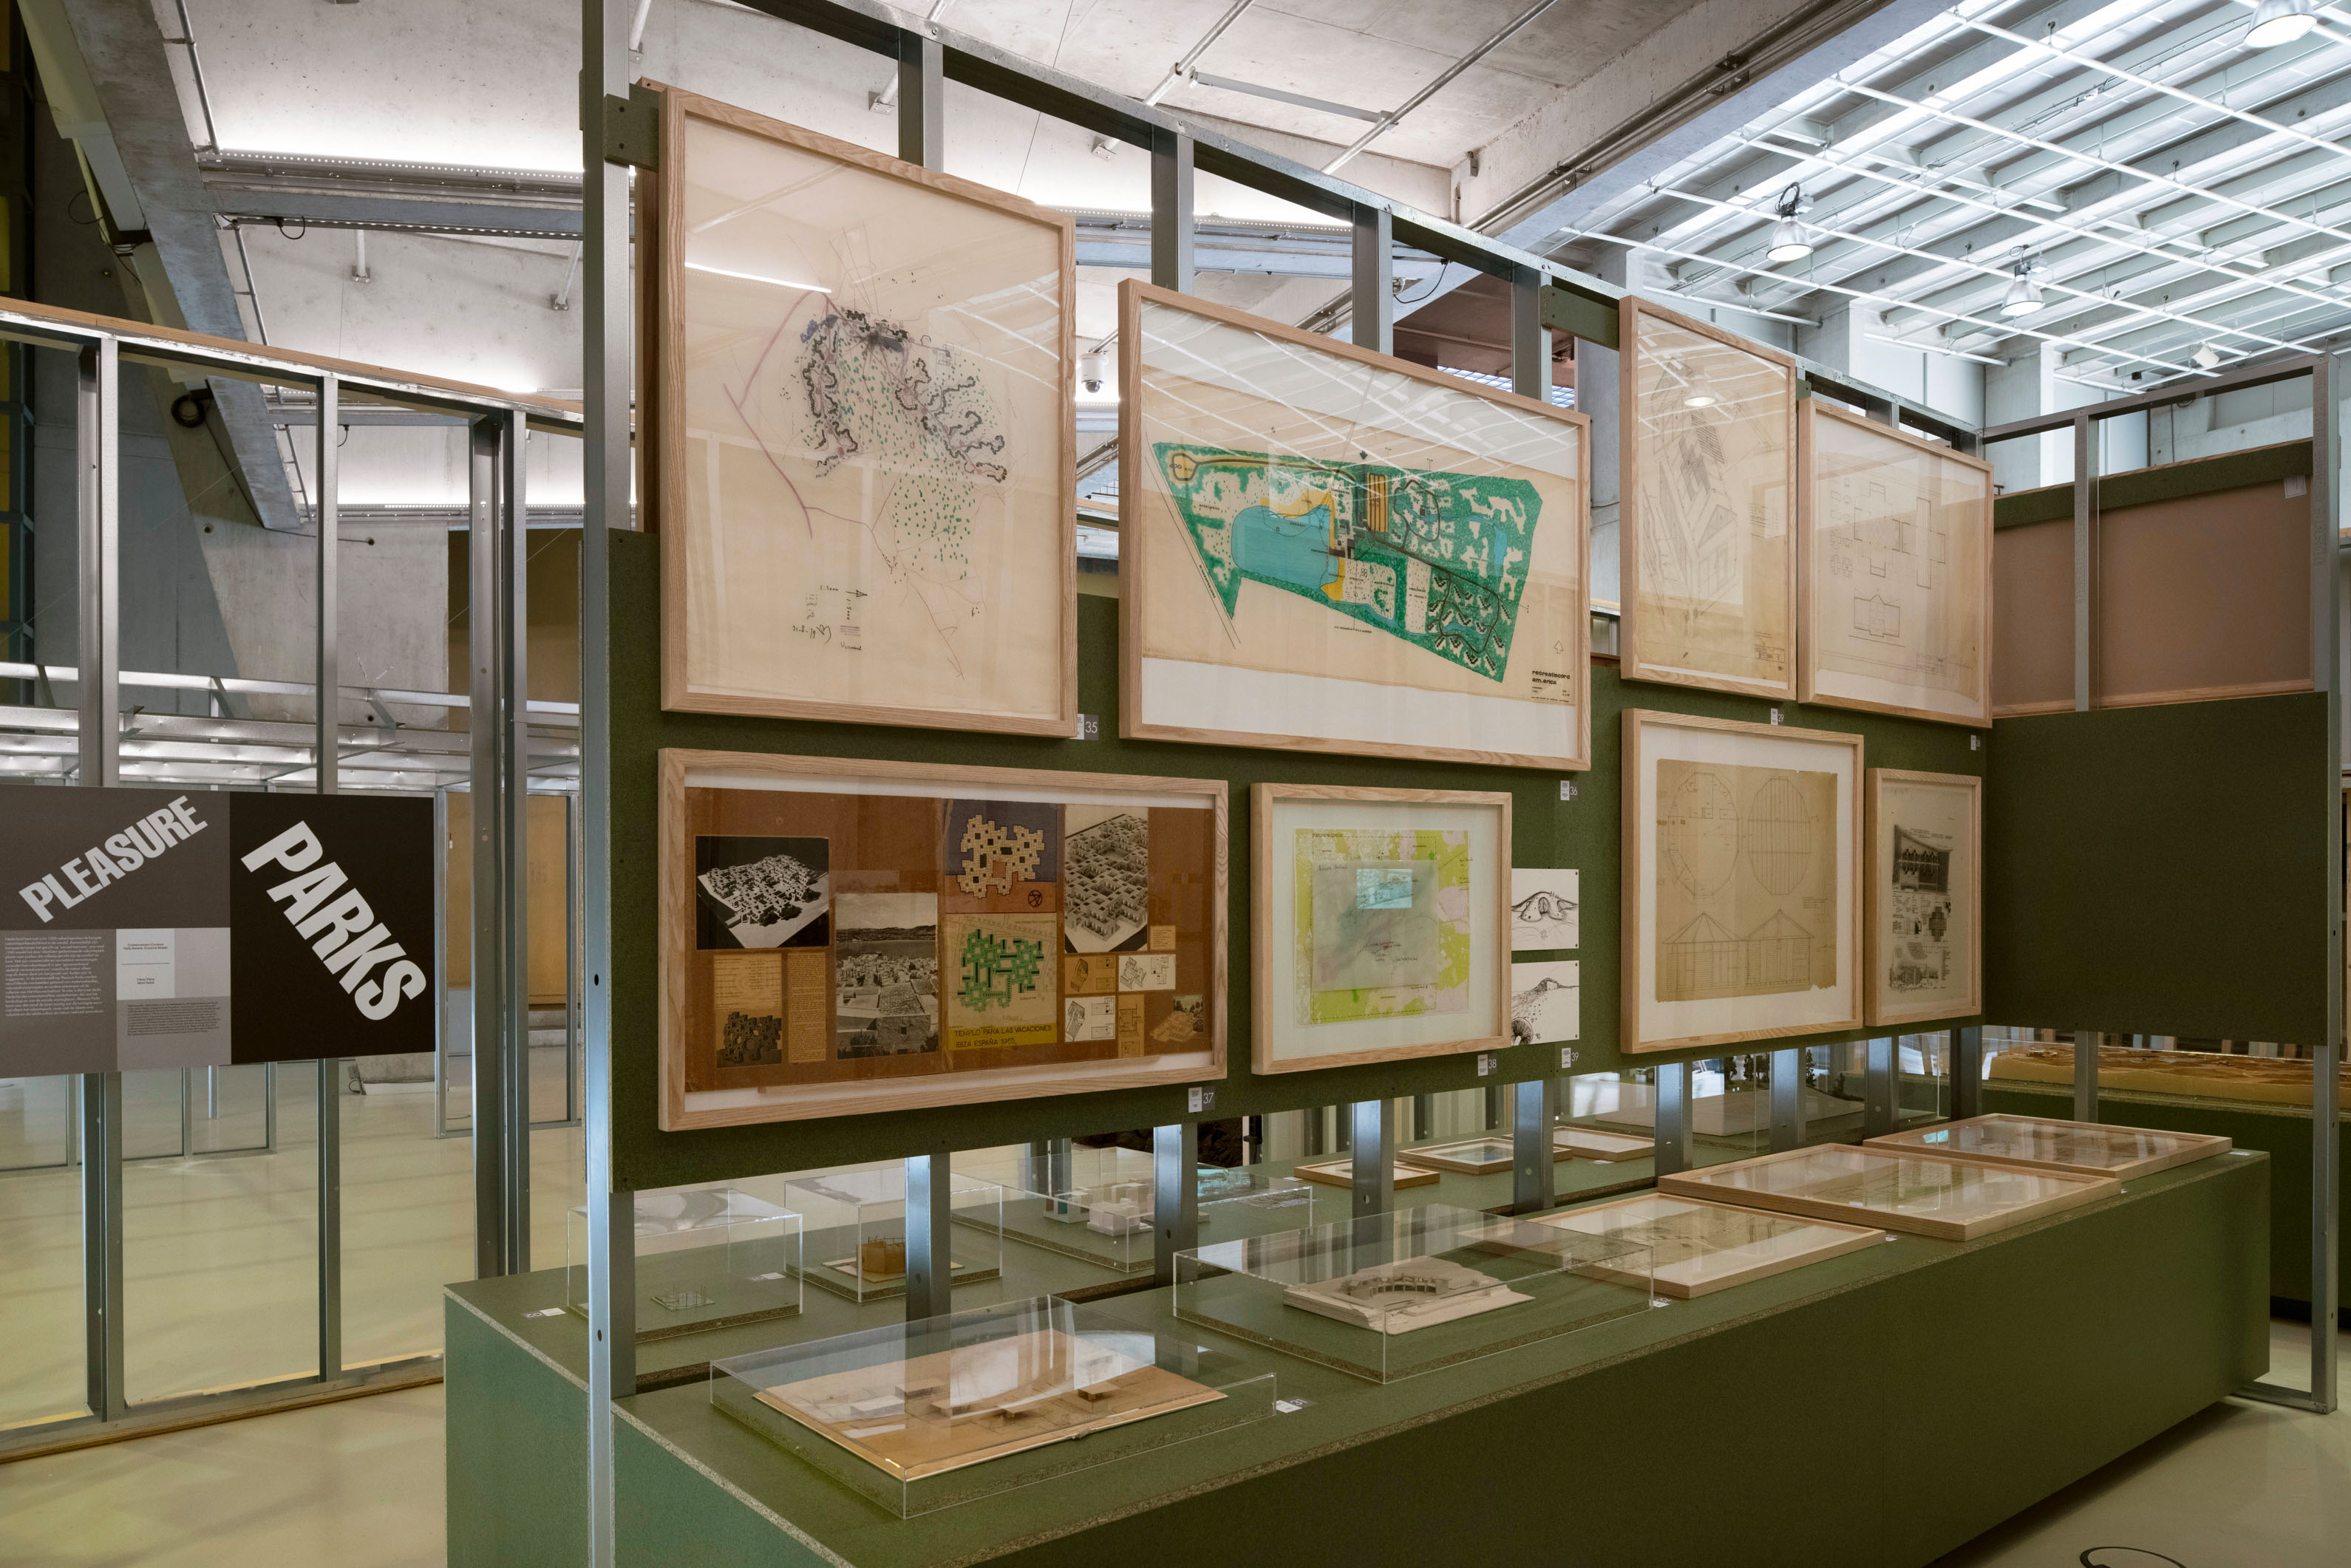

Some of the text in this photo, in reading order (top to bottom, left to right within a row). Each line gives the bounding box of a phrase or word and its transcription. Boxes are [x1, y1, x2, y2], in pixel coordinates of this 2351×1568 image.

[1777, 714, 1784, 722] 29
[1085, 720, 1098, 734] 35
[1570, 785, 1578, 796] 36
[18, 795, 208, 923] PLEASURE
[240, 820, 427, 1021] PARKS
[955, 1029, 981, 1037] TEMPLO
[1015, 1025, 1052, 1033] VACACIONES
[974, 1038, 998, 1047] ESPAÑA
[1571, 1052, 1579, 1062] 39
[1488, 1058, 1497, 1069] 38
[1203, 1092, 1214, 1104] 37
